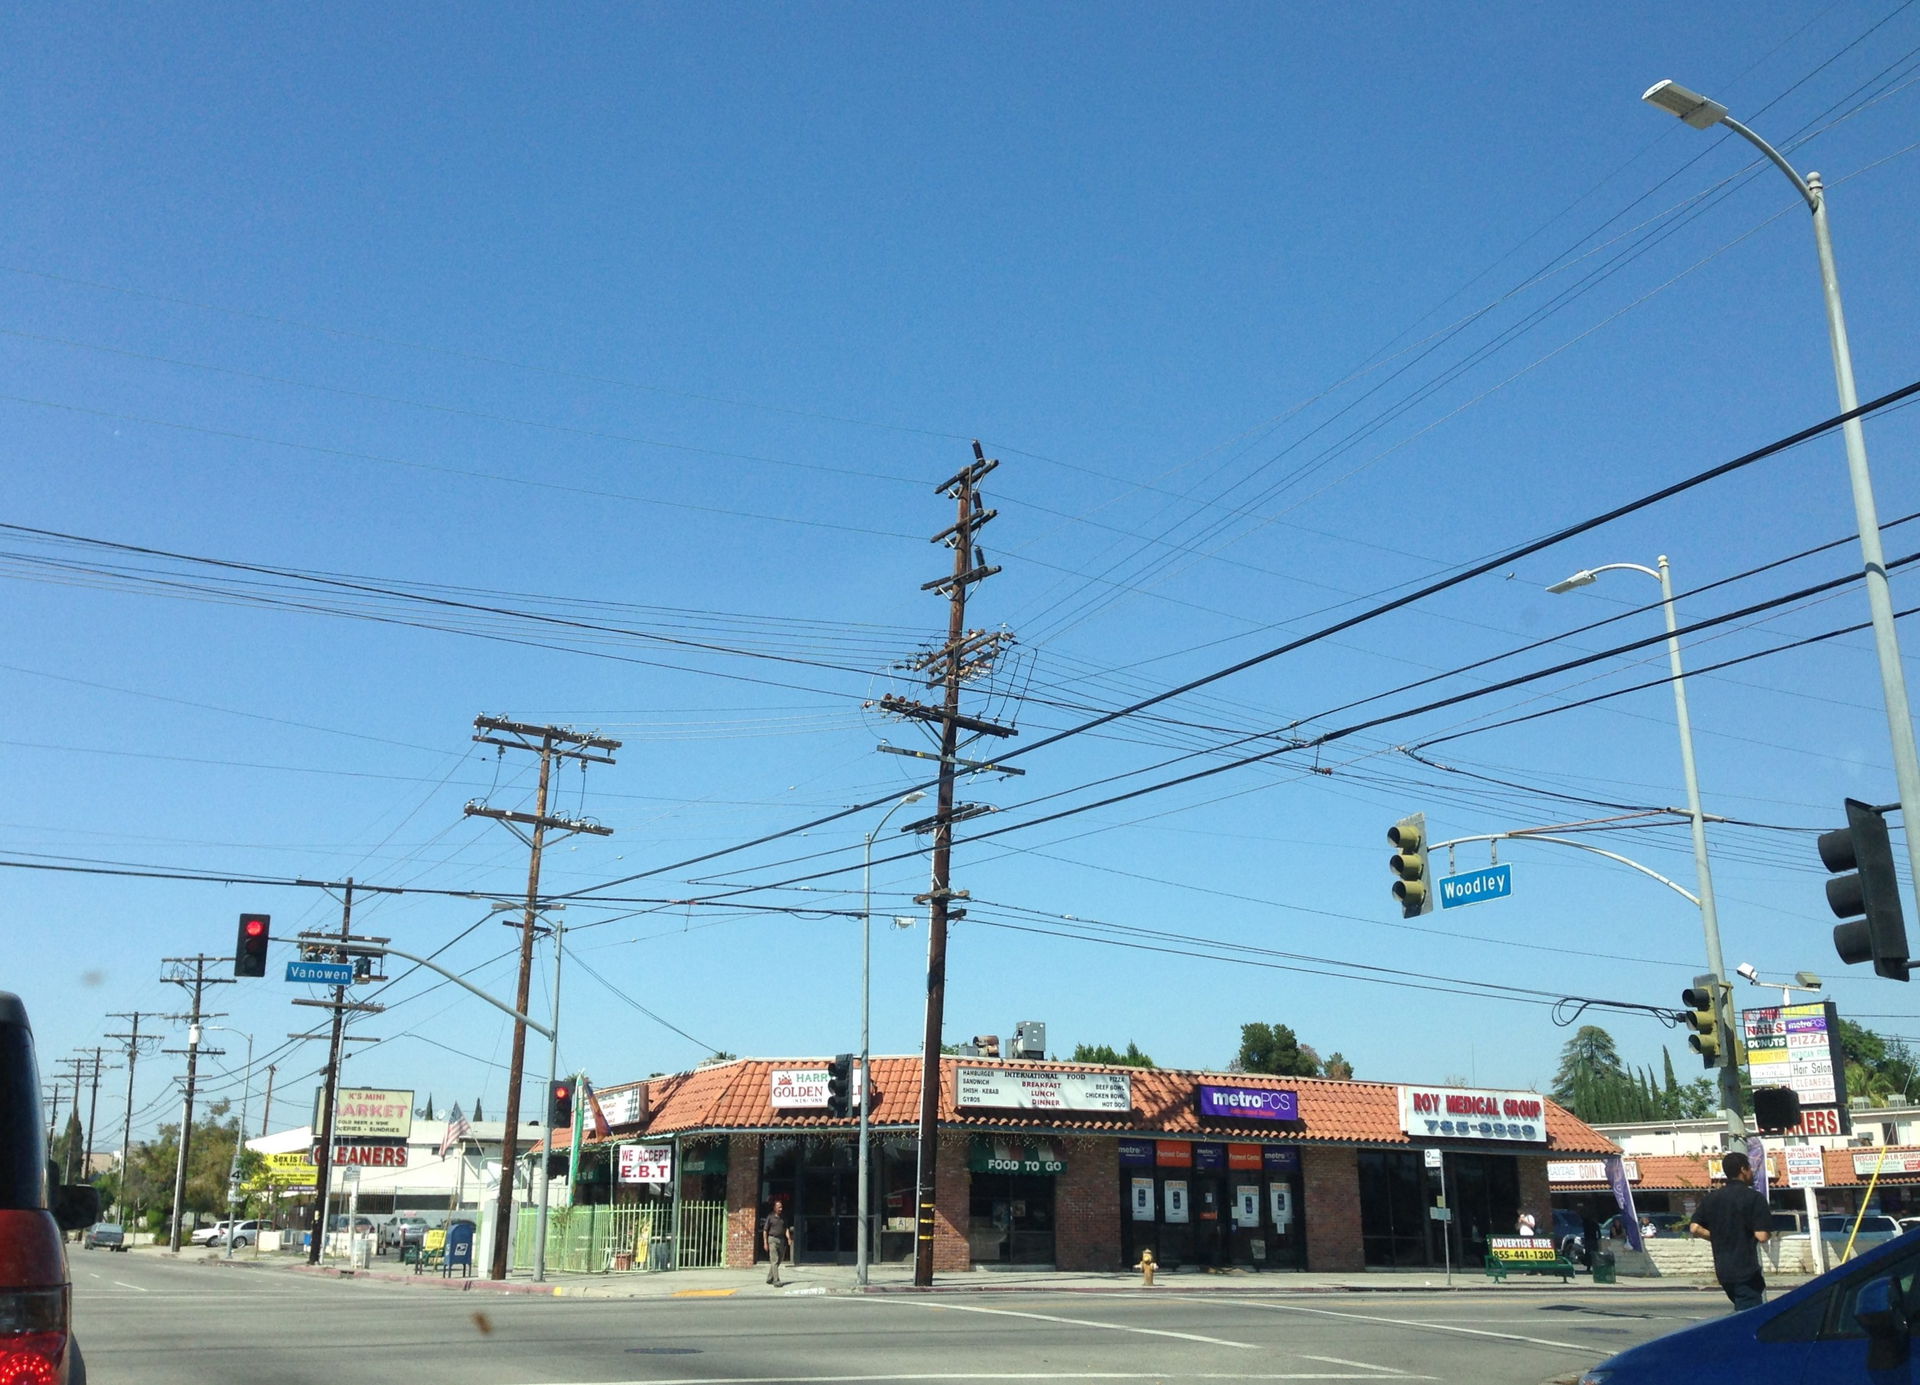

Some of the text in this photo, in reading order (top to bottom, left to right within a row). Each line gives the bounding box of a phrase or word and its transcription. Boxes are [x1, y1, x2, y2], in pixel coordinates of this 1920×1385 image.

[1444, 874, 1505, 899] Woodley
[291, 966, 348, 980] Vanowen
[1747, 1023, 1783, 1036] NAILS
[1747, 1037, 1786, 1048] DONUTS
[1790, 1035, 1827, 1046] PIZZA
[1793, 1064, 1808, 1075] Hair
[1812, 1063, 1832, 1074] Salon
[796, 1073, 830, 1083] HARR
[1004, 1071, 1058, 1080] INTERNATIONAL
[1021, 1081, 1061, 1089] BREAKFAST
[773, 1086, 823, 1098] GOLDEN
[1213, 1091, 1290, 1110] metroPCS
[1413, 1093, 1541, 1120] ROY MEDICAL GROUP
[336, 1103, 408, 1118] ARKET
[273, 1154, 288, 1164] Sex
[314, 1146, 406, 1165] CEANERS
[622, 1150, 668, 1162] WE ACCEPT
[621, 1165, 668, 1178] E.B.T
[988, 1159, 1062, 1172] FOOD TO GO
[1578, 1164, 1598, 1179] COIN
[1492, 1239, 1552, 1248] ADVERTISE HERE
[1493, 1250, 1554, 1259] 855-441-1300
